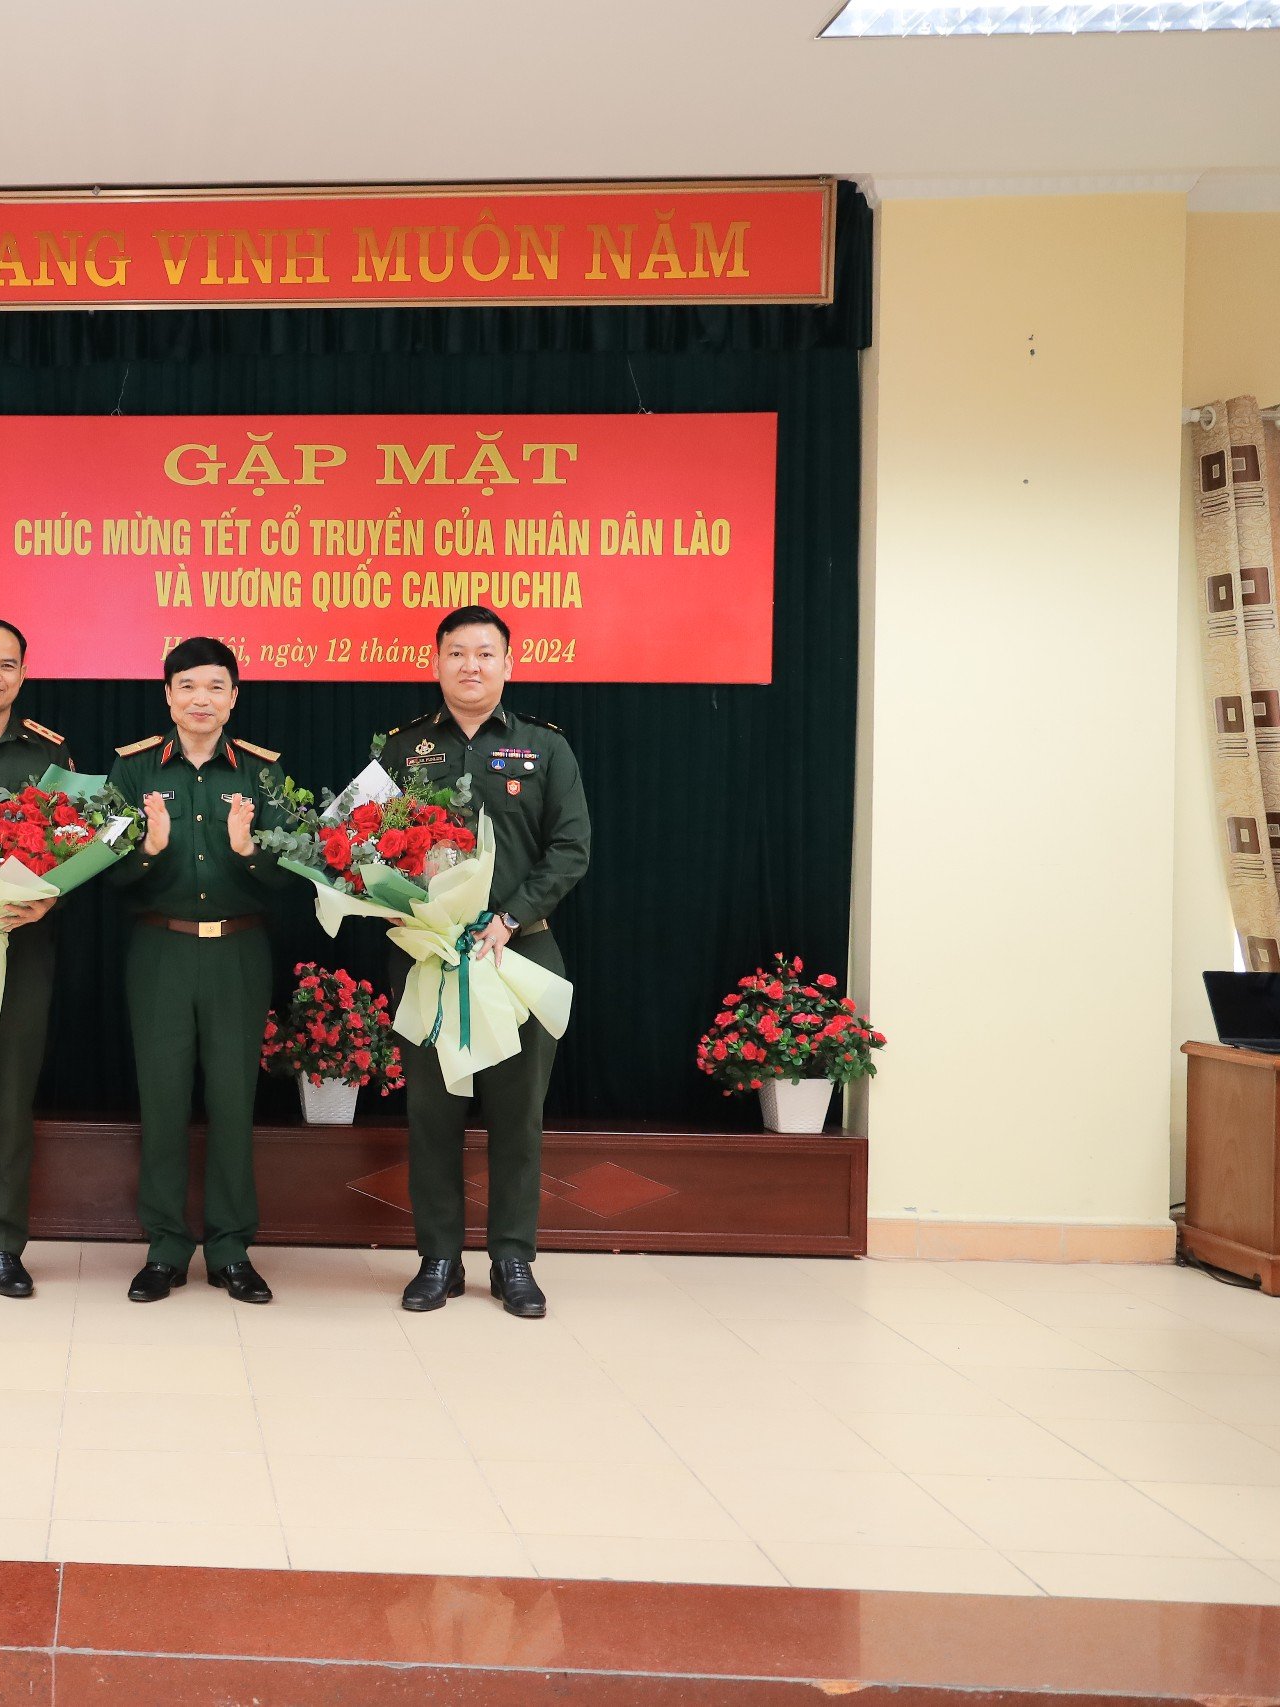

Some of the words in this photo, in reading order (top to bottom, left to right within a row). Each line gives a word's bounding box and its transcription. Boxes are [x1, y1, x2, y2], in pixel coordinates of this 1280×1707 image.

[152, 227, 332, 286] VINH
[351, 207, 563, 284] MUÔN
[583, 206, 751, 281] NĂM
[163, 431, 348, 497] GẶP
[375, 430, 579, 497] MẶT
[14, 508, 92, 556] CHÚC
[103, 508, 191, 557] MỪNG
[201, 506, 251, 557] TẾT
[260, 504, 301, 556] CỔ
[309, 508, 425, 557] TRUYỀN
[434, 506, 495, 557] CỦA
[504, 510, 591, 557] NHÂN
[600, 510, 664, 557] DÂN
[673, 508, 731, 557] LÀO
[155, 559, 193, 608] VÀ
[201, 568, 303, 609] VƯƠNG
[312, 557, 393, 613] QUỐC
[400, 570, 583, 610] CAMPUCHIA
[260, 636, 319, 668] ngày
[325, 638, 353, 663] 12
[360, 637, 432, 669] tháng
[519, 638, 577, 664] 2024
